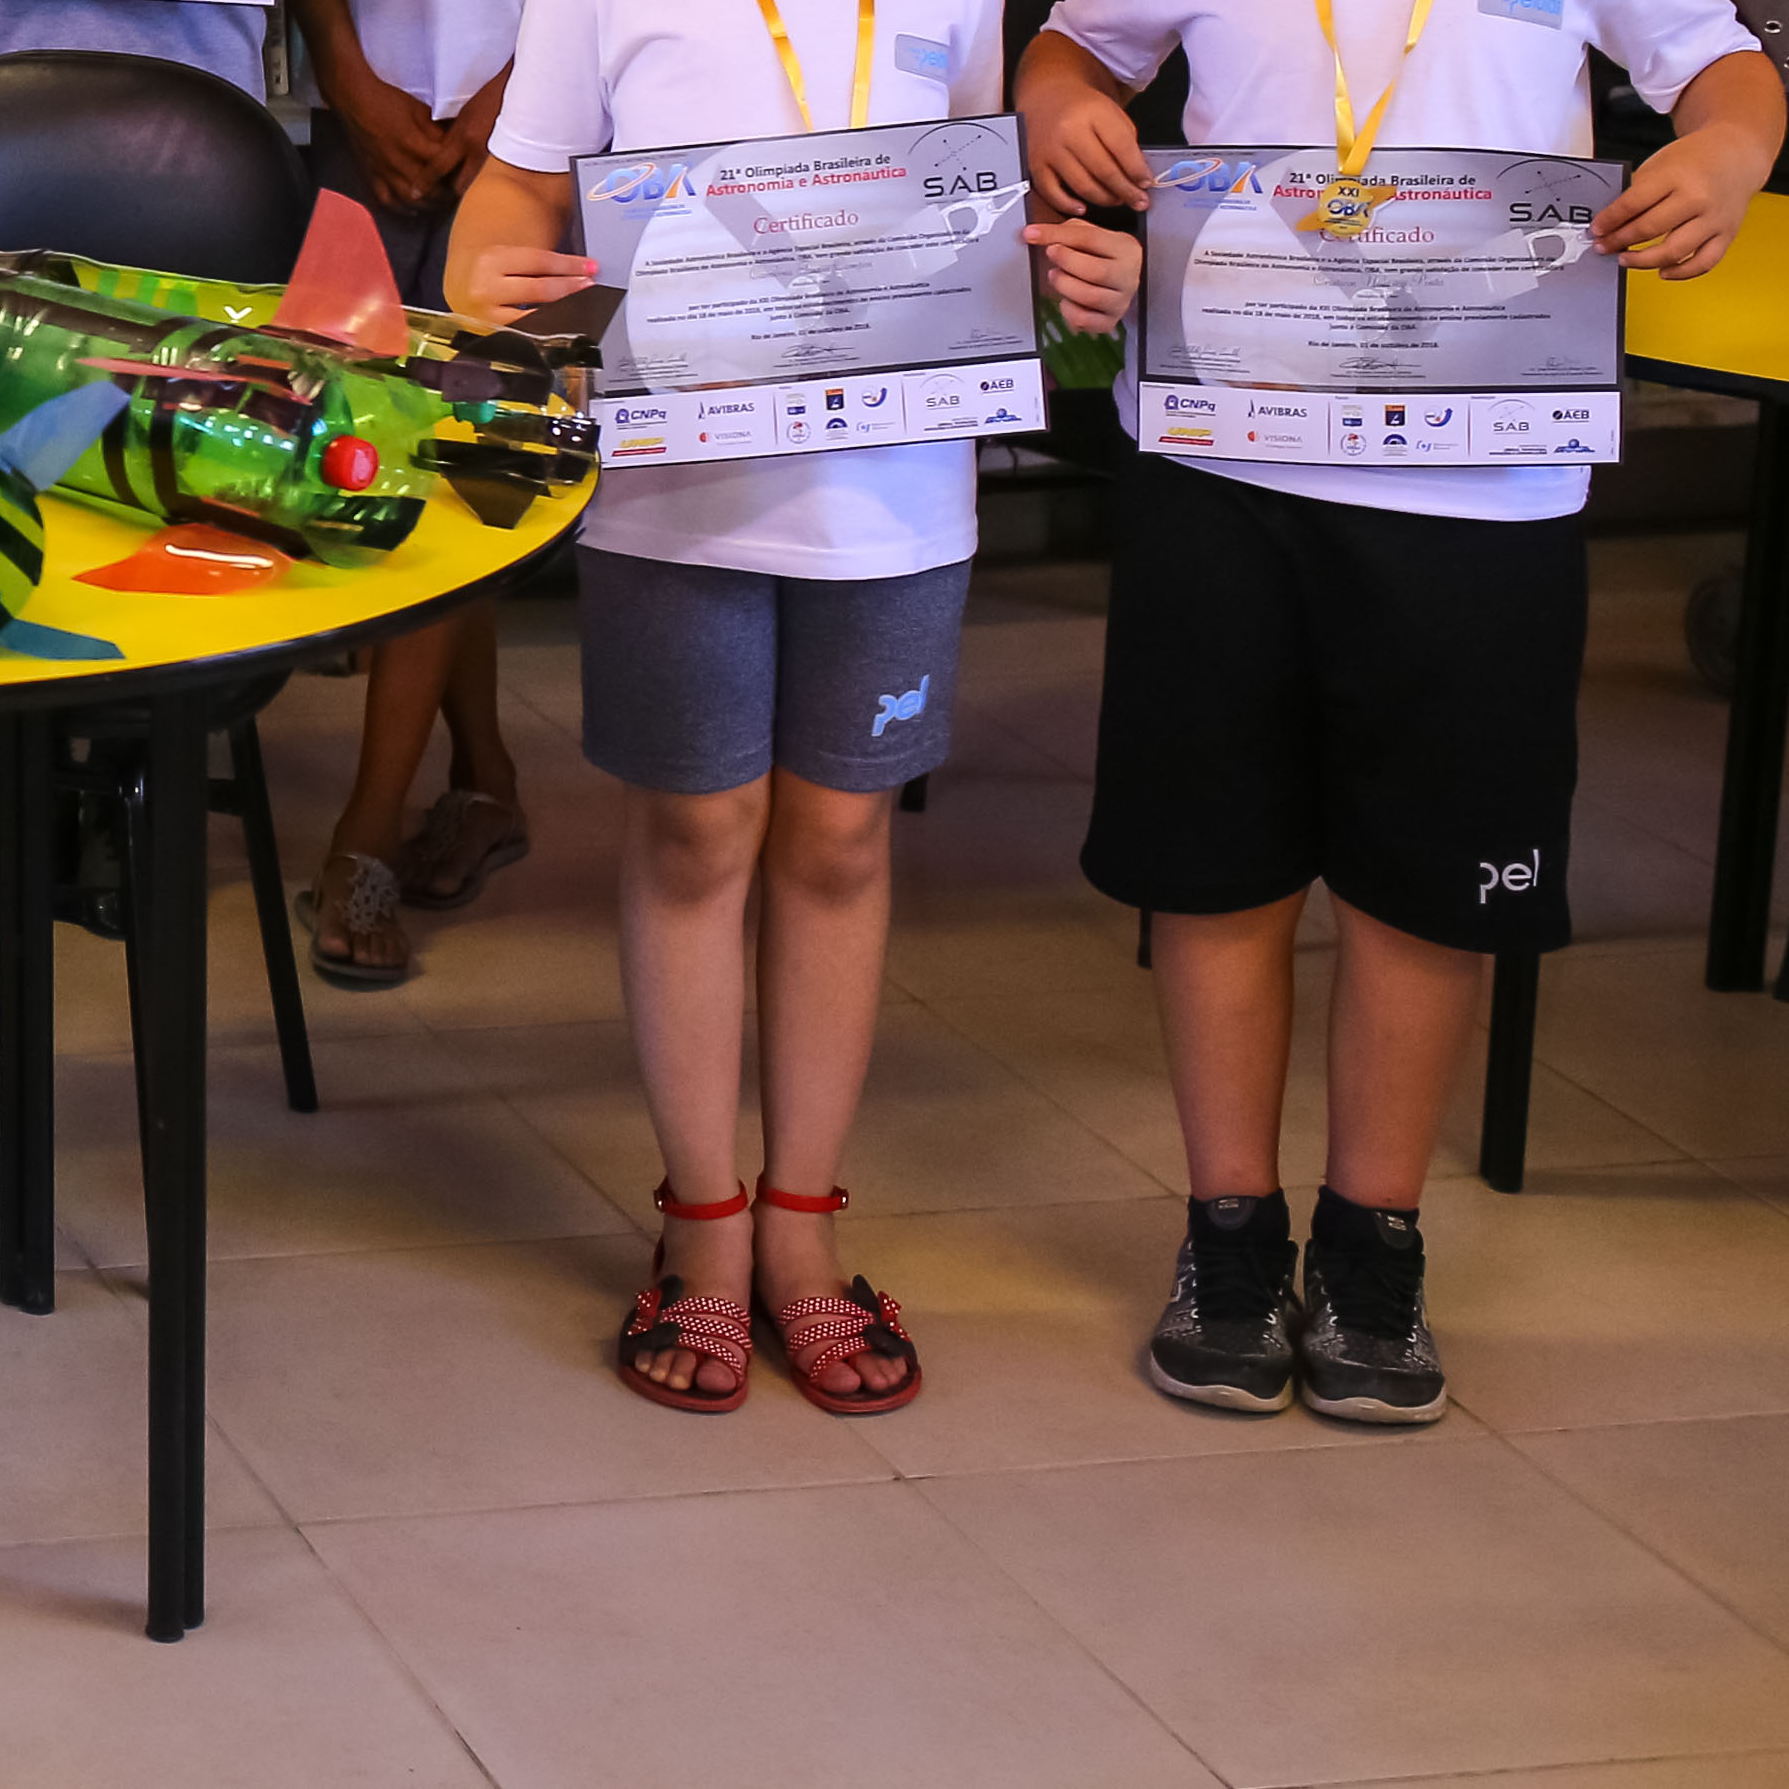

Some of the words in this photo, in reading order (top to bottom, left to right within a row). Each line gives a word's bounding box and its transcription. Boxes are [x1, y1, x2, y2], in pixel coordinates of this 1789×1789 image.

[744, 162, 810, 180] Olimpíada
[814, 156, 872, 171] Brasileira
[875, 153, 891, 165] de
[1172, 160, 1263, 195] OBA
[606, 162, 698, 203] OBA
[706, 178, 795, 197] Astronomia
[811, 165, 907, 186] Astronáutica
[923, 171, 998, 197] SAB
[1337, 186, 1360, 197] XXI
[1391, 173, 1454, 188] Brasileira
[1458, 174, 1476, 186] de
[753, 210, 859, 235] Certificado
[1508, 203, 1594, 225] SAB
[1258, 406, 1308, 419] AVIBRAS
[1563, 409, 1591, 421] AEB
[871, 674, 931, 737] pel
[1478, 848, 1540, 904] pel
